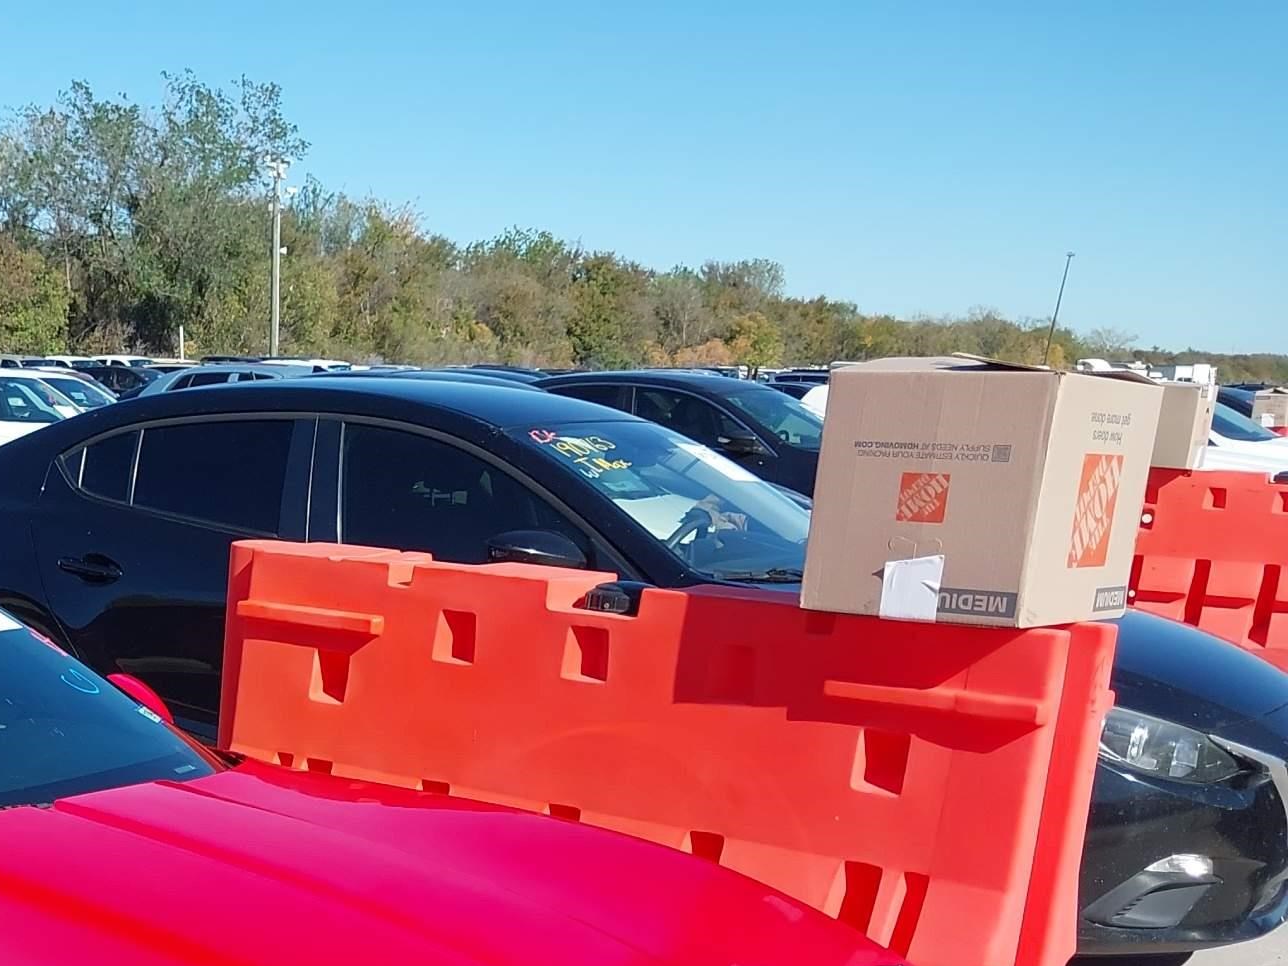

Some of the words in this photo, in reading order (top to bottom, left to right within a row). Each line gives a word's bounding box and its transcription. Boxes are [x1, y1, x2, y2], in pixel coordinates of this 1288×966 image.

[854, 440, 919, 450] HDMOVING.COM
[919, 442, 930, 450] AT
[931, 443, 959, 451] NEEDS
[961, 444, 991, 453] SUPPLY
[857, 449, 890, 458] PACKING
[892, 450, 913, 459] YOUR
[914, 451, 953, 460] ESTIMATE
[955, 452, 989, 462] QUICKLY
[900, 474, 931, 501] DEPOT
[898, 474, 949, 520] HOME
[1070, 455, 1121, 563] HOME
[938, 592, 1008, 613] MEDIU
[1096, 591, 1124, 608] MEDIUM
